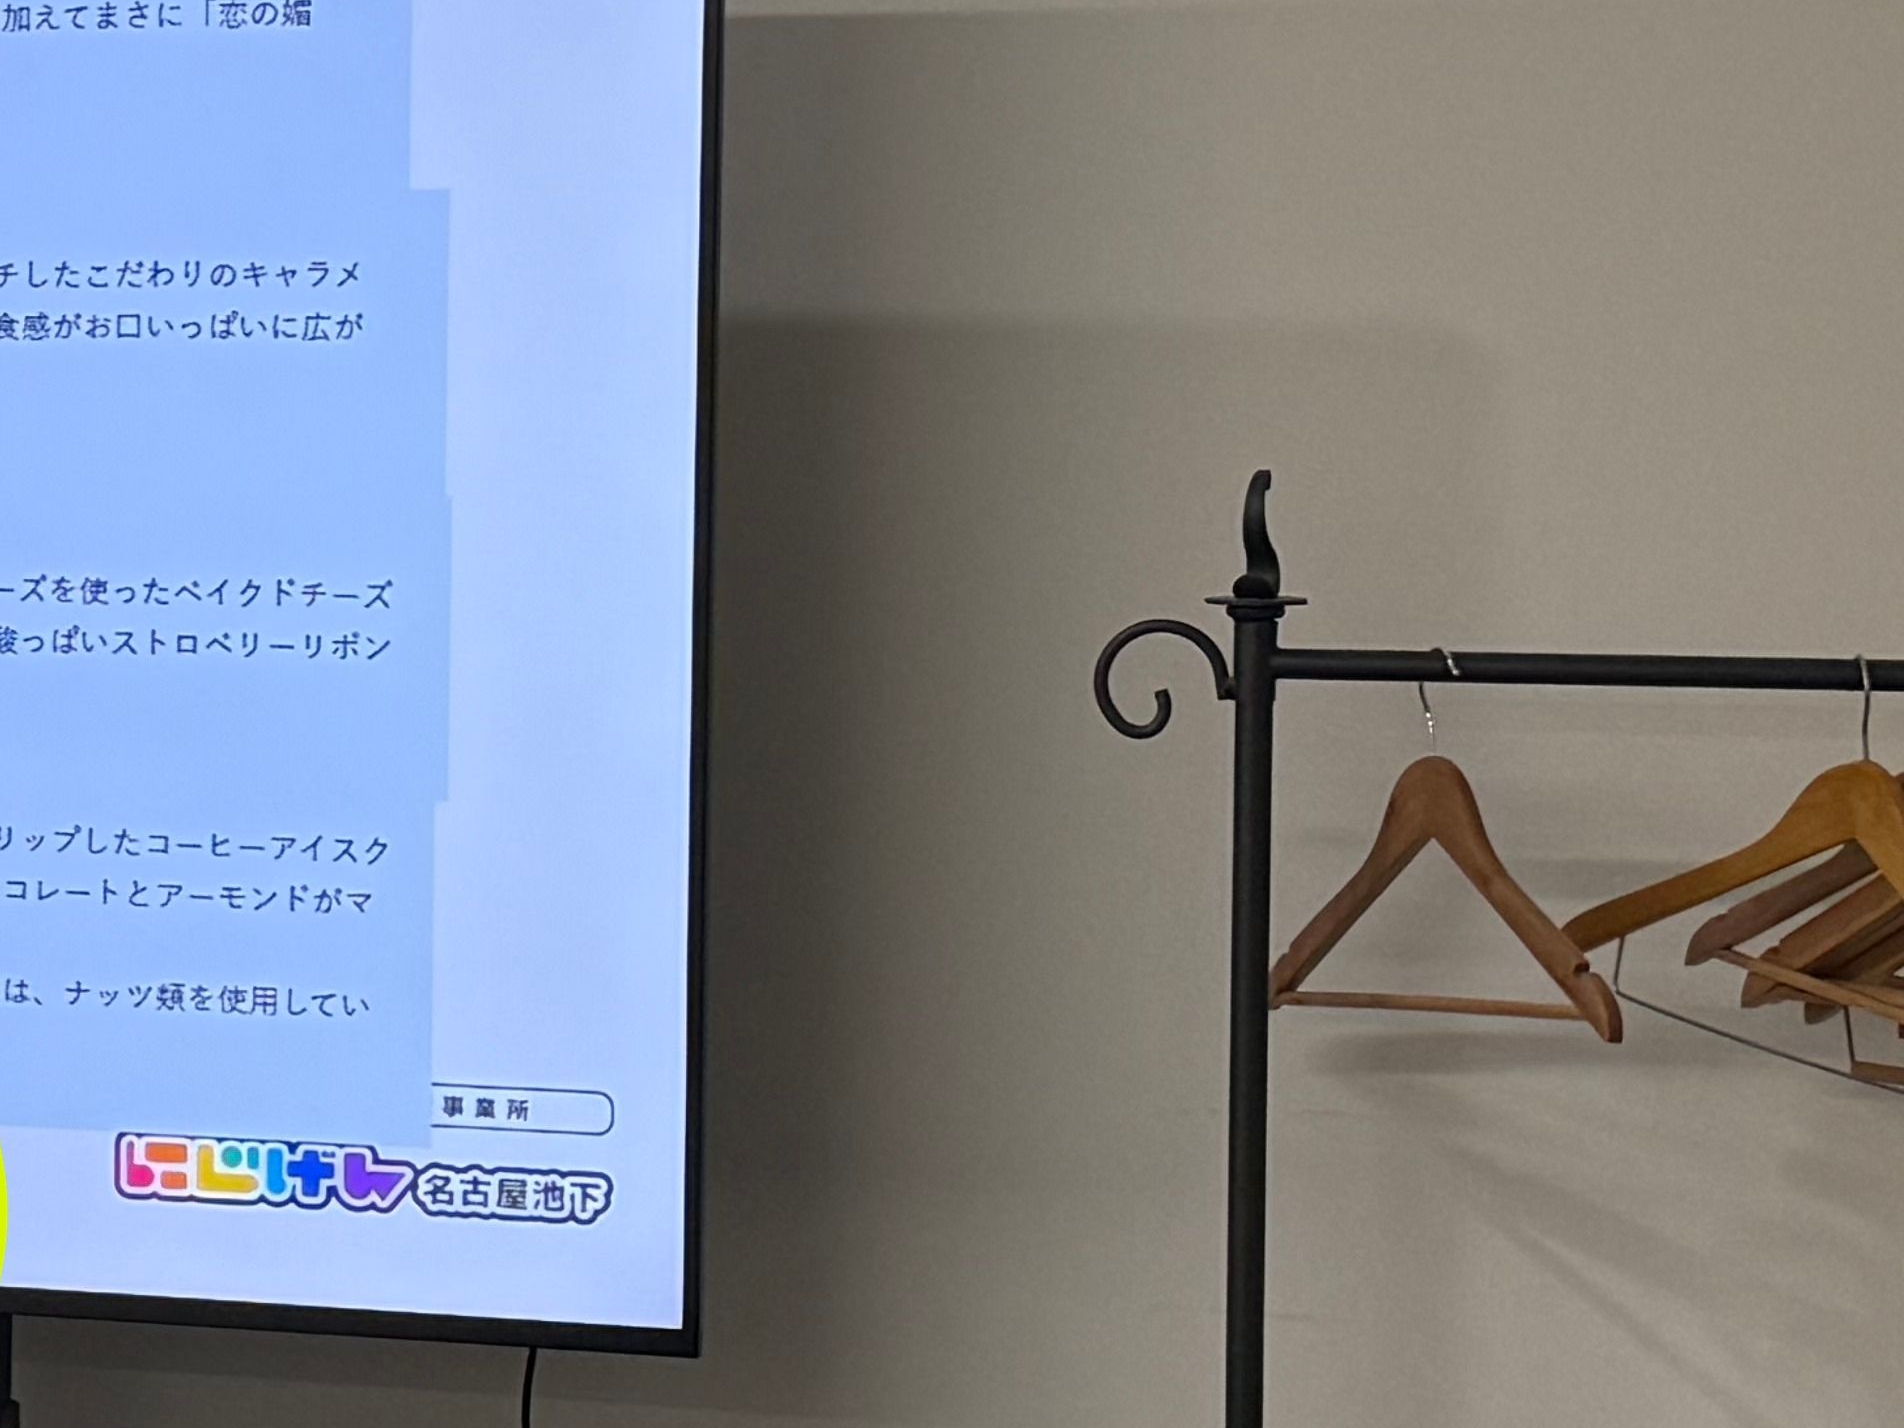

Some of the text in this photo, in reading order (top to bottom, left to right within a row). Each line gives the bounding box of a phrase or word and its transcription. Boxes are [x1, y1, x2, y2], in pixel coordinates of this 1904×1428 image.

[442, 1096, 530, 1124] 事業所
[422, 1173, 608, 1220] 名古屋池下
